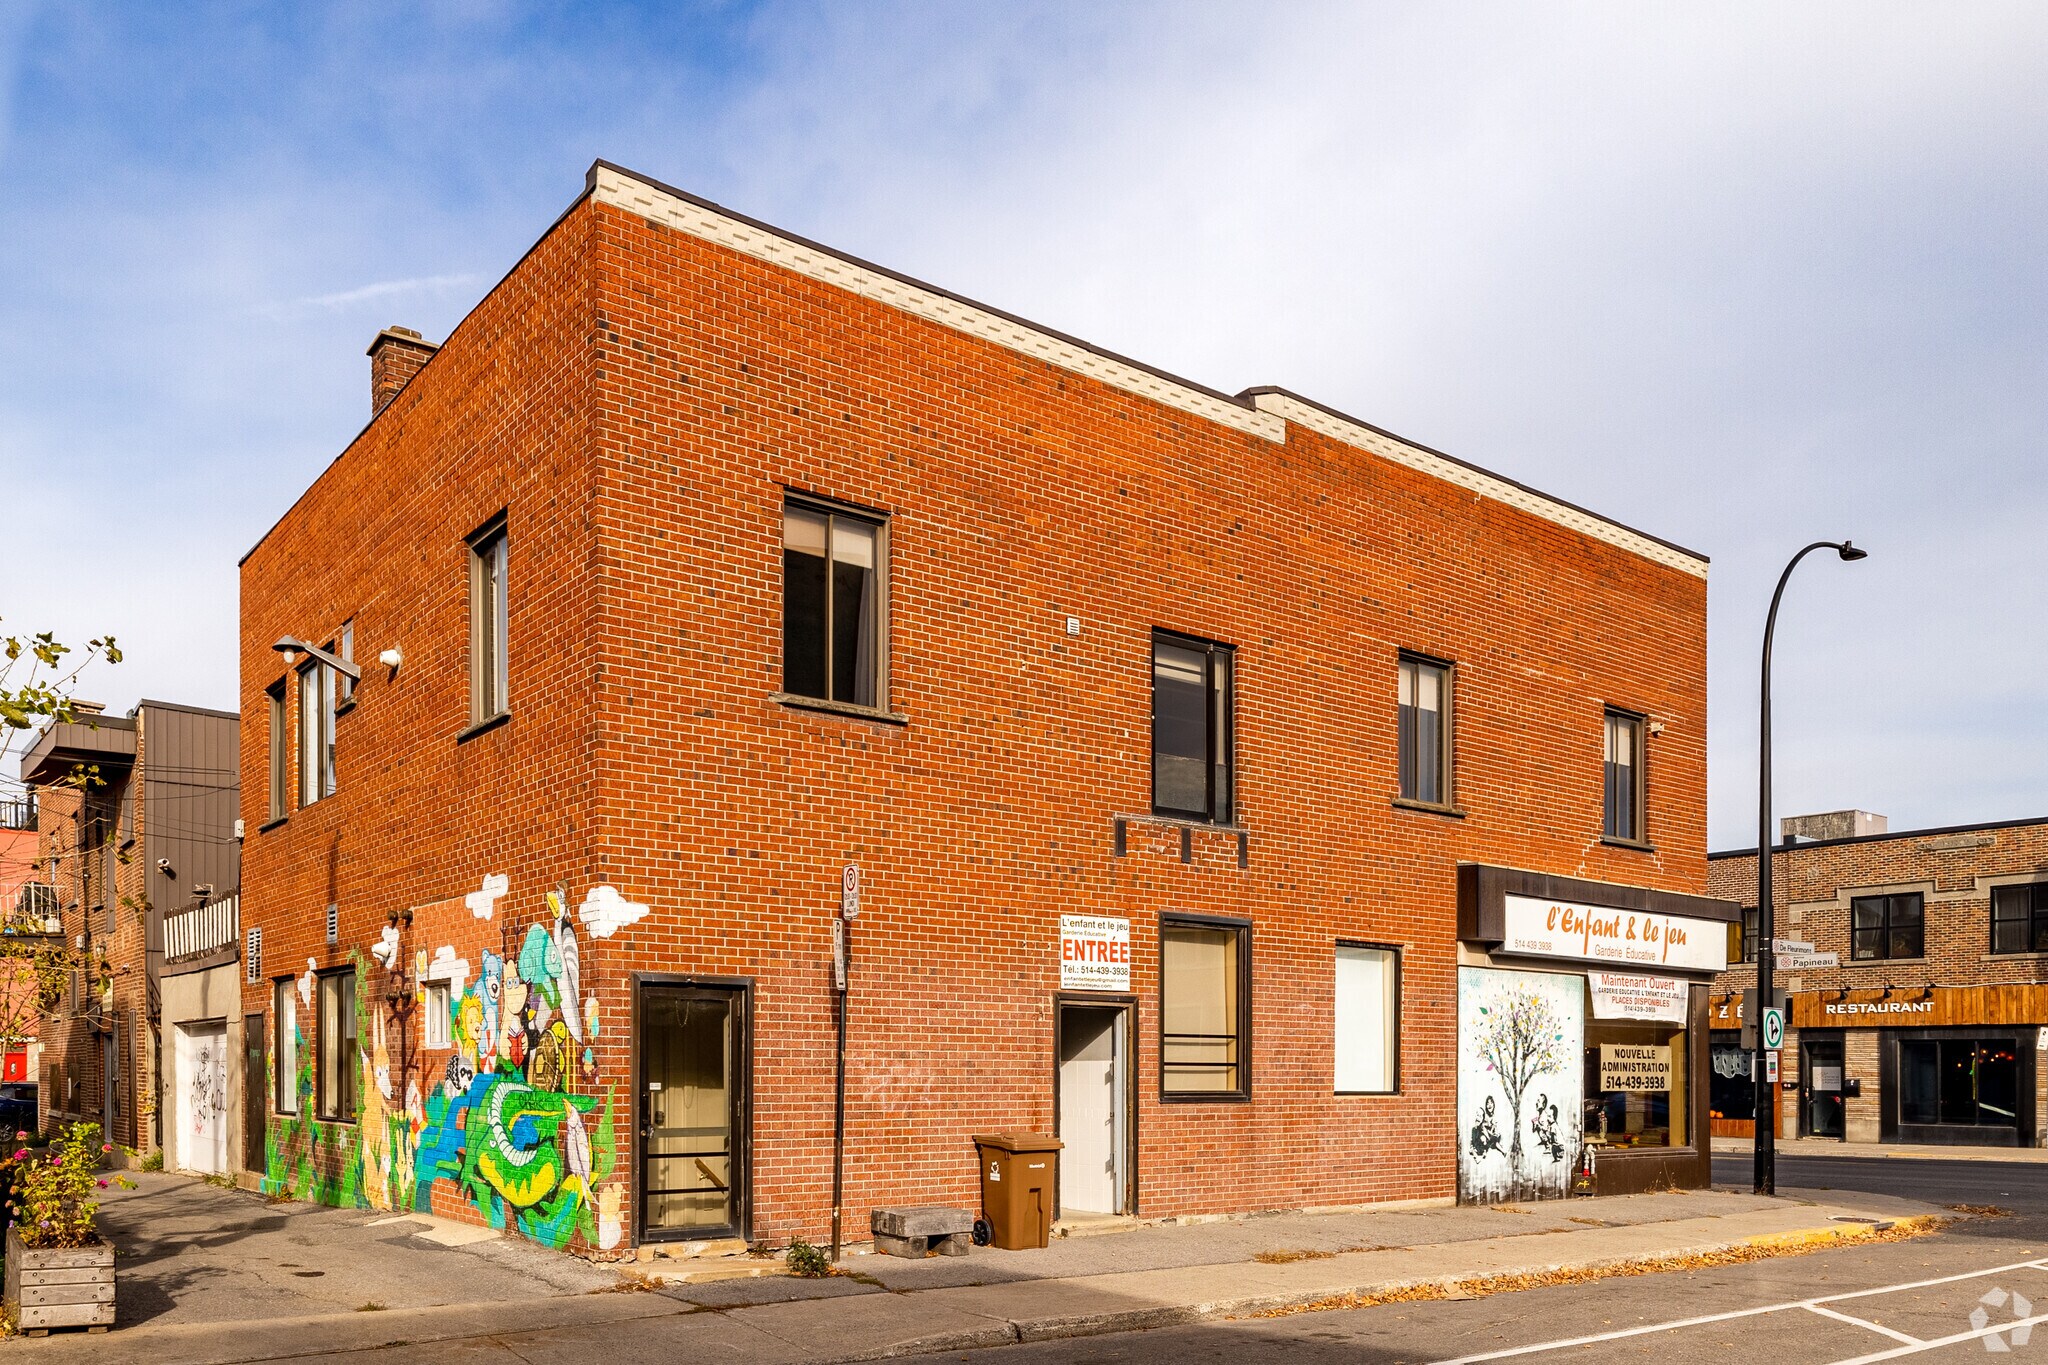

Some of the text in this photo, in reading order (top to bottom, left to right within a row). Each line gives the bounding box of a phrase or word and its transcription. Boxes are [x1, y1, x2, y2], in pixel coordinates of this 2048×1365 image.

[1062, 918, 1128, 932] L'enfant et le jeu
[1547, 906, 1619, 955] l'Enfant
[1626, 916, 1636, 940] &
[1643, 918, 1658, 942] le
[1063, 936, 1129, 963] ENTRÉE
[1515, 939, 1552, 951] 514 439 3938
[1595, 944, 1622, 958] Garderie
[1780, 944, 1786, 952] De
[1793, 959, 1833, 968] Papineau
[1081, 966, 1129, 976] 514-439-3938
[1601, 974, 1675, 990] Maintenant Ouvert
[1612, 996, 1633, 1004] PLACES
[1634, 997, 1670, 1007] DISPONIBLES
[1826, 1002, 1934, 1014] RESTAURANT
[1614, 1049, 1656, 1059] NOUVELLE
[1602, 1062, 1670, 1072] ADMINISTRATION
[1606, 1076, 1665, 1089] 514-439-3938
